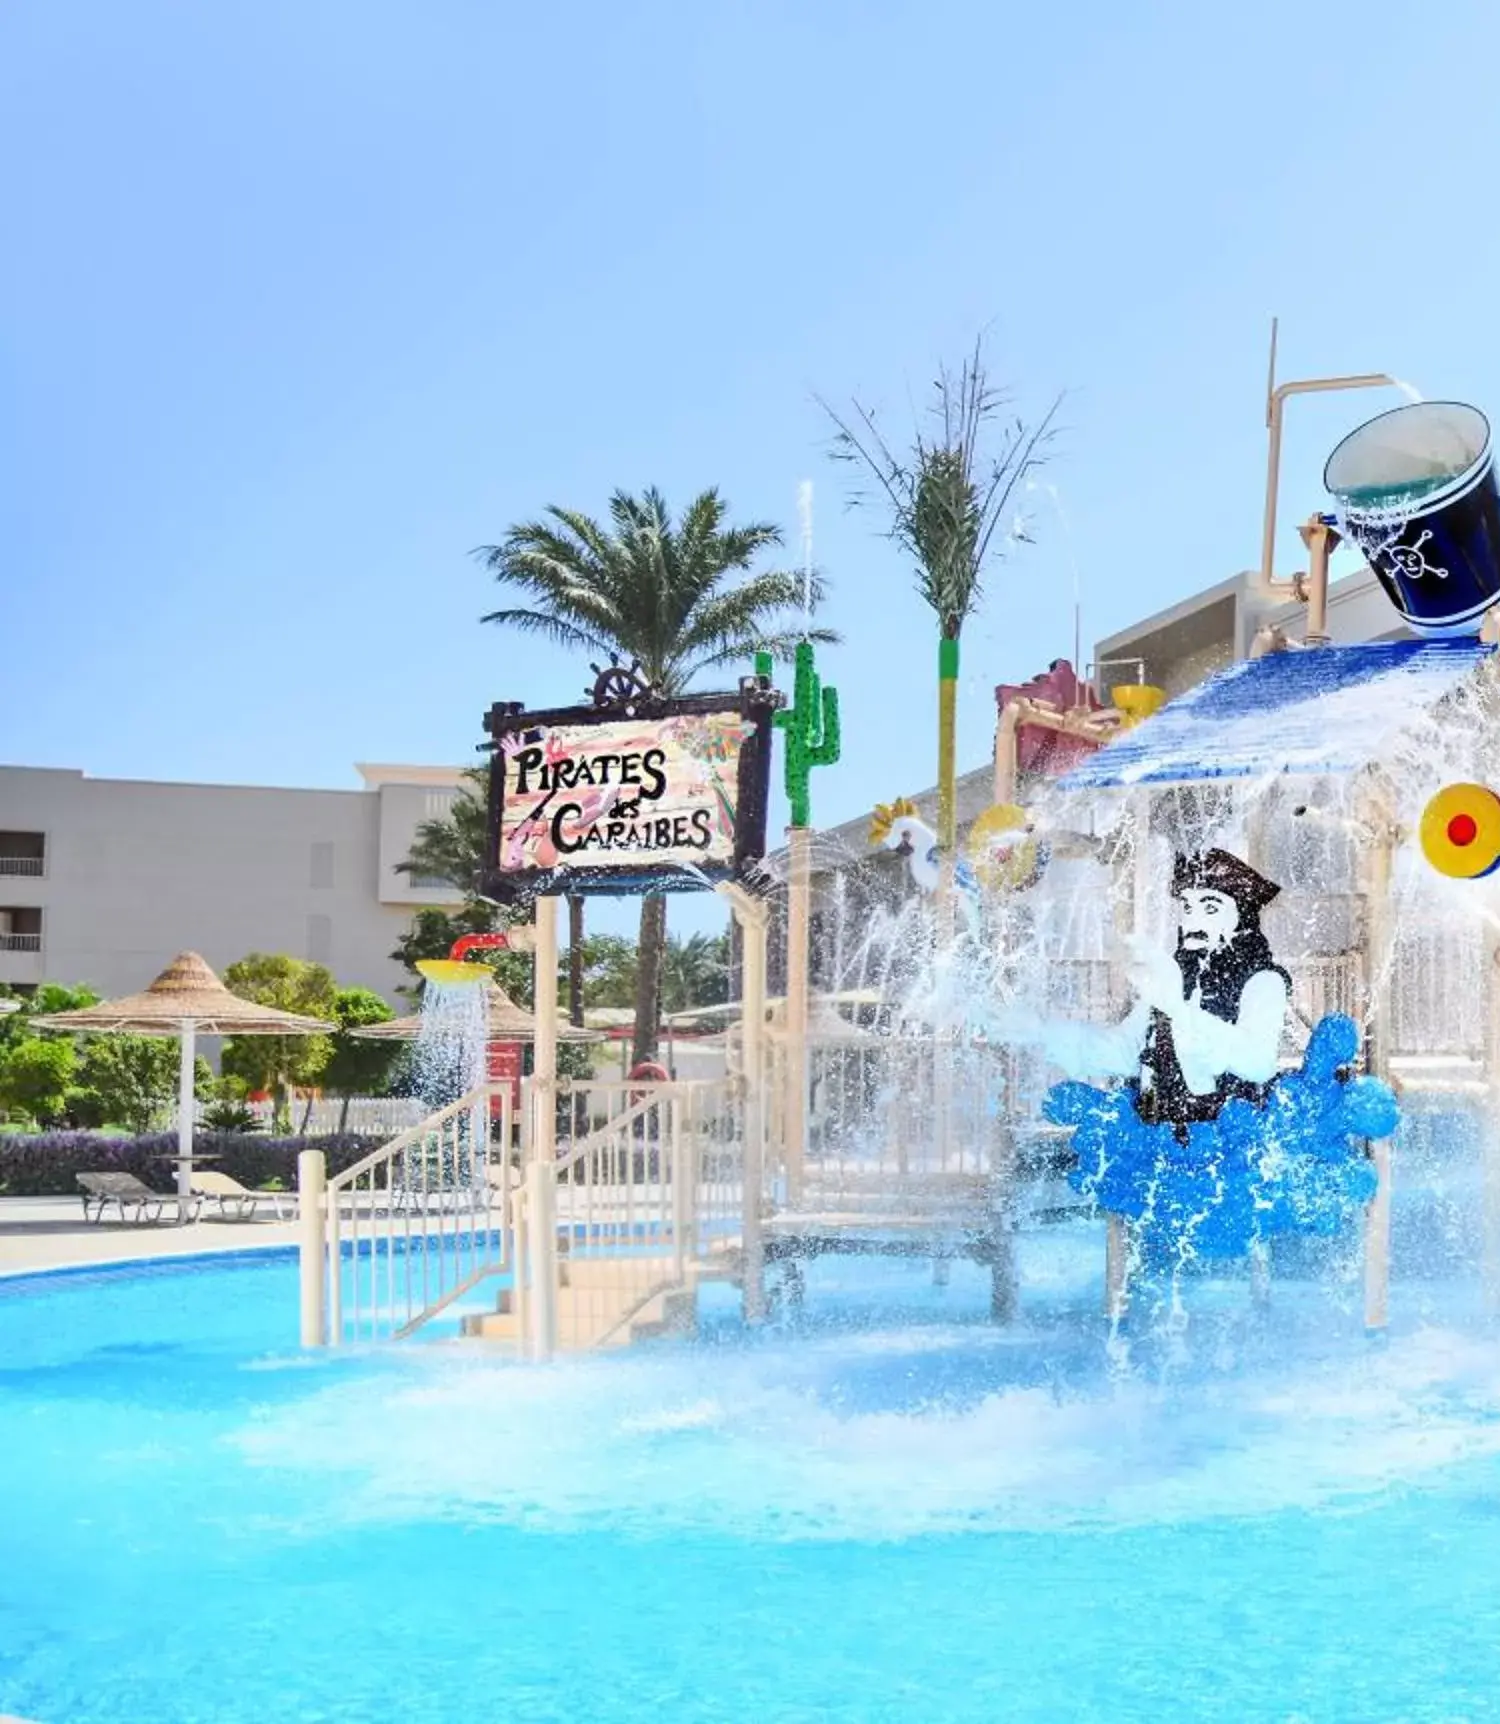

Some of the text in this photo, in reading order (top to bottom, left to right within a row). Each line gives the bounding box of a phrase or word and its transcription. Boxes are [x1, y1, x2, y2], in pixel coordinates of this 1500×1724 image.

[512, 748, 667, 800] PIRATES
[551, 803, 712, 854] CARAIBES
[609, 797, 641, 819] des
